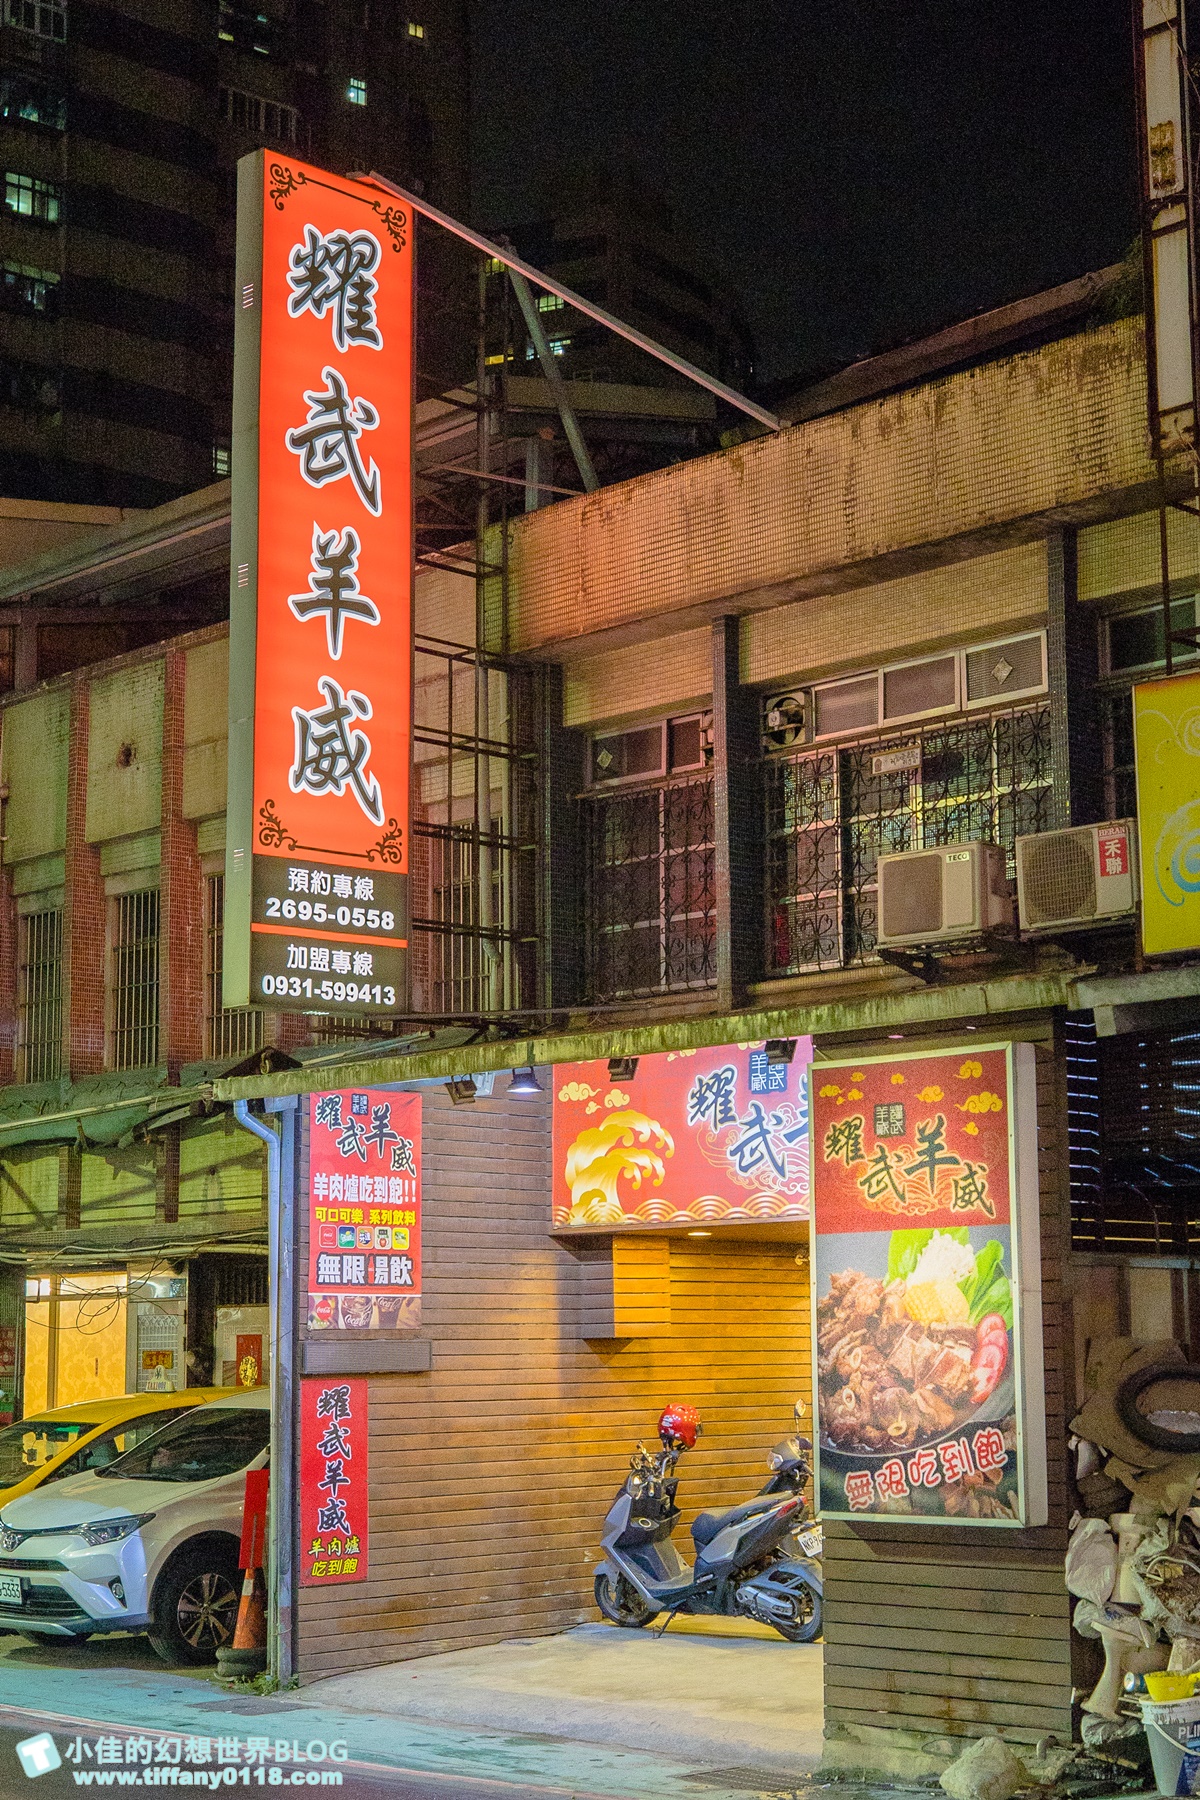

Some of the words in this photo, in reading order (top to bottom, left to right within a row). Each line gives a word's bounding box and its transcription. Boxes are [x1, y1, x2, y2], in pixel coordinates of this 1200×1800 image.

[286, 223, 384, 827] 耀武羊威
[948, 852, 967, 861] TECO
[1105, 839, 1122, 875] 禾聯
[288, 867, 374, 901] 預約專線
[266, 897, 395, 930] 2695-0558
[287, 944, 373, 976] 加盟專線
[262, 975, 396, 1005] 0931-599413
[316, 1094, 416, 1178] 耀武羊威
[824, 1113, 996, 1218] 耀武羊威
[313, 1172, 417, 1205] 羊肉爐吃到飽!!
[315, 1206, 364, 1225] 可口可樂
[369, 1208, 416, 1227] 系列飲料
[317, 1385, 352, 1535] 耀武羊威
[844, 1427, 1008, 1511] 無限吃到飽
[308, 1537, 361, 1560] 羊肉爐
[311, 1558, 358, 1577] 吃到飽
[1178, 1724, 1200, 1740] PLI
